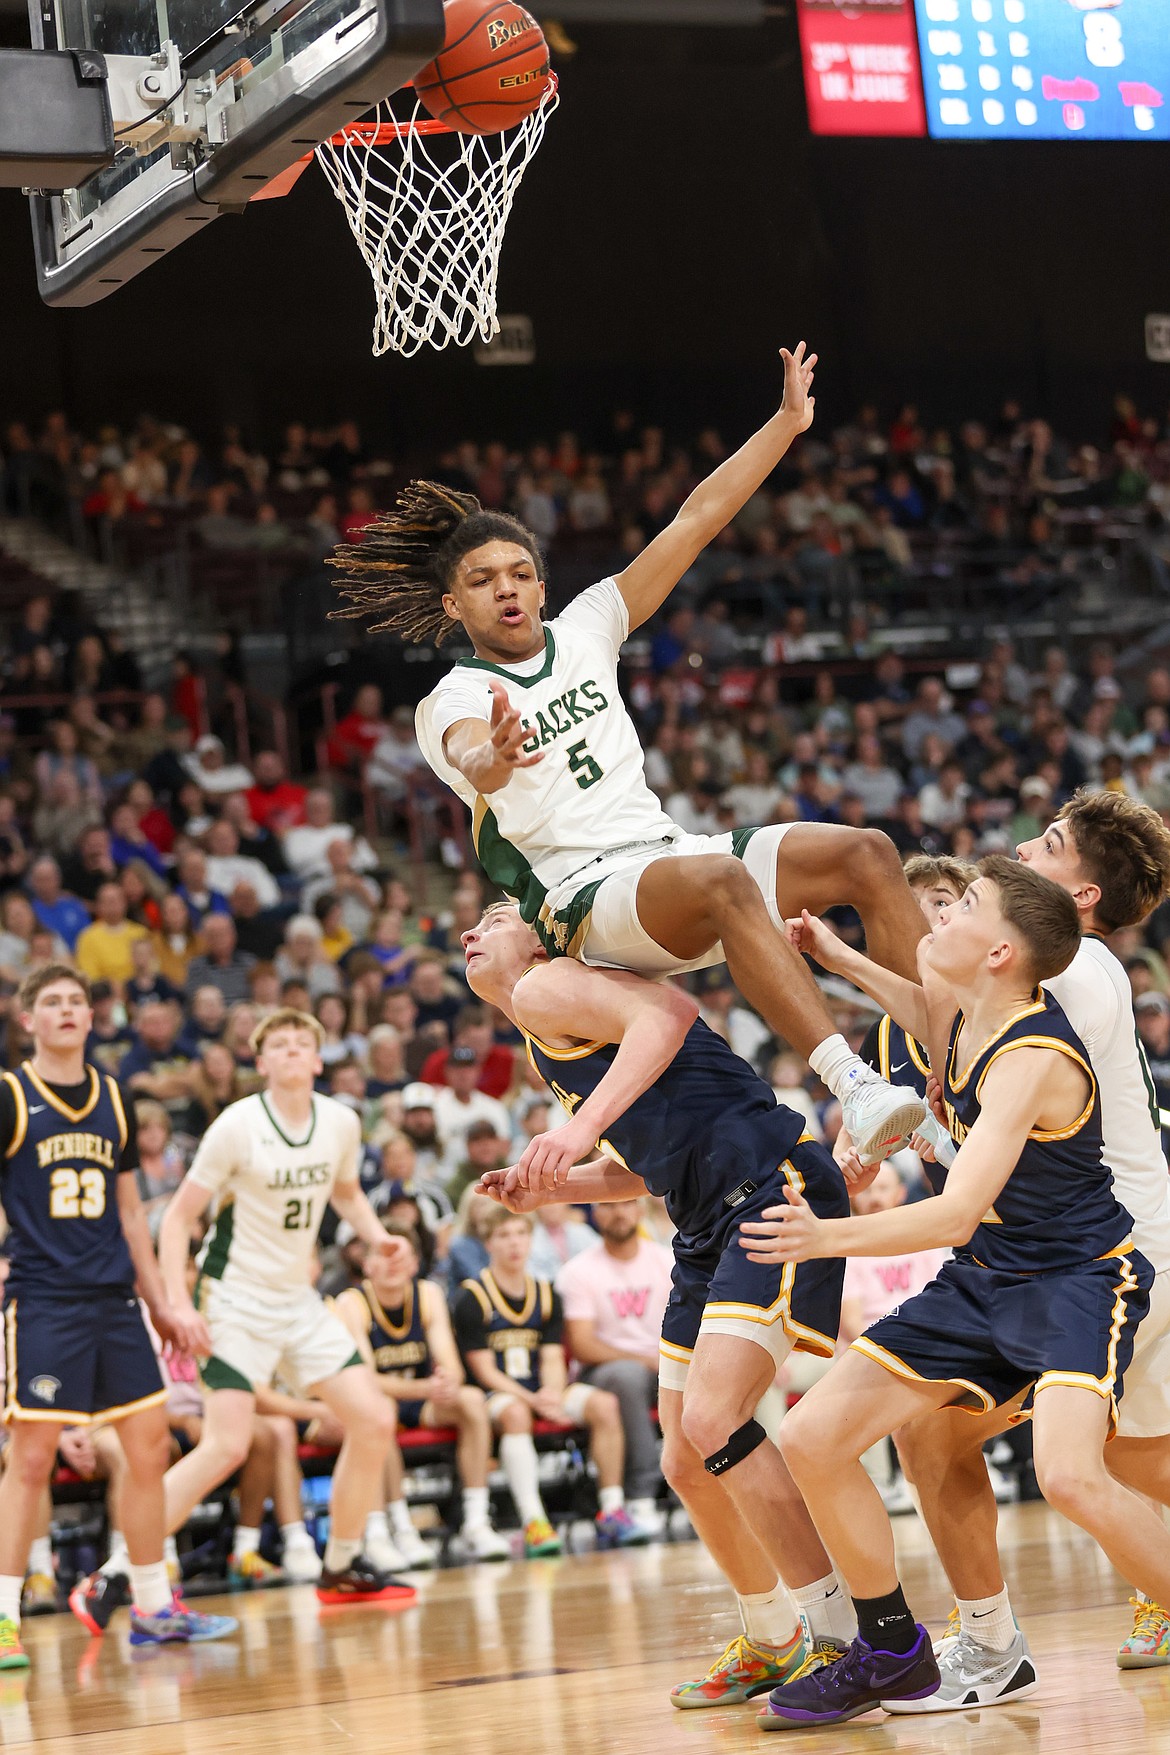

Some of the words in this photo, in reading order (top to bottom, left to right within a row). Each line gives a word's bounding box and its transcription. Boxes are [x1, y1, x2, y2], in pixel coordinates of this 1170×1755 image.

[1083, 11, 1125, 67] 8
[850, 73, 909, 102] JUNE
[521, 679, 609, 754] JACKS
[565, 737, 605, 790] 5
[35, 1132, 115, 1169] WENDELL
[50, 1167, 106, 1219] 23
[266, 1162, 330, 1190] JACKS
[284, 1198, 313, 1229] 21
[876, 1262, 912, 1293] W
[609, 1286, 651, 1318] W
